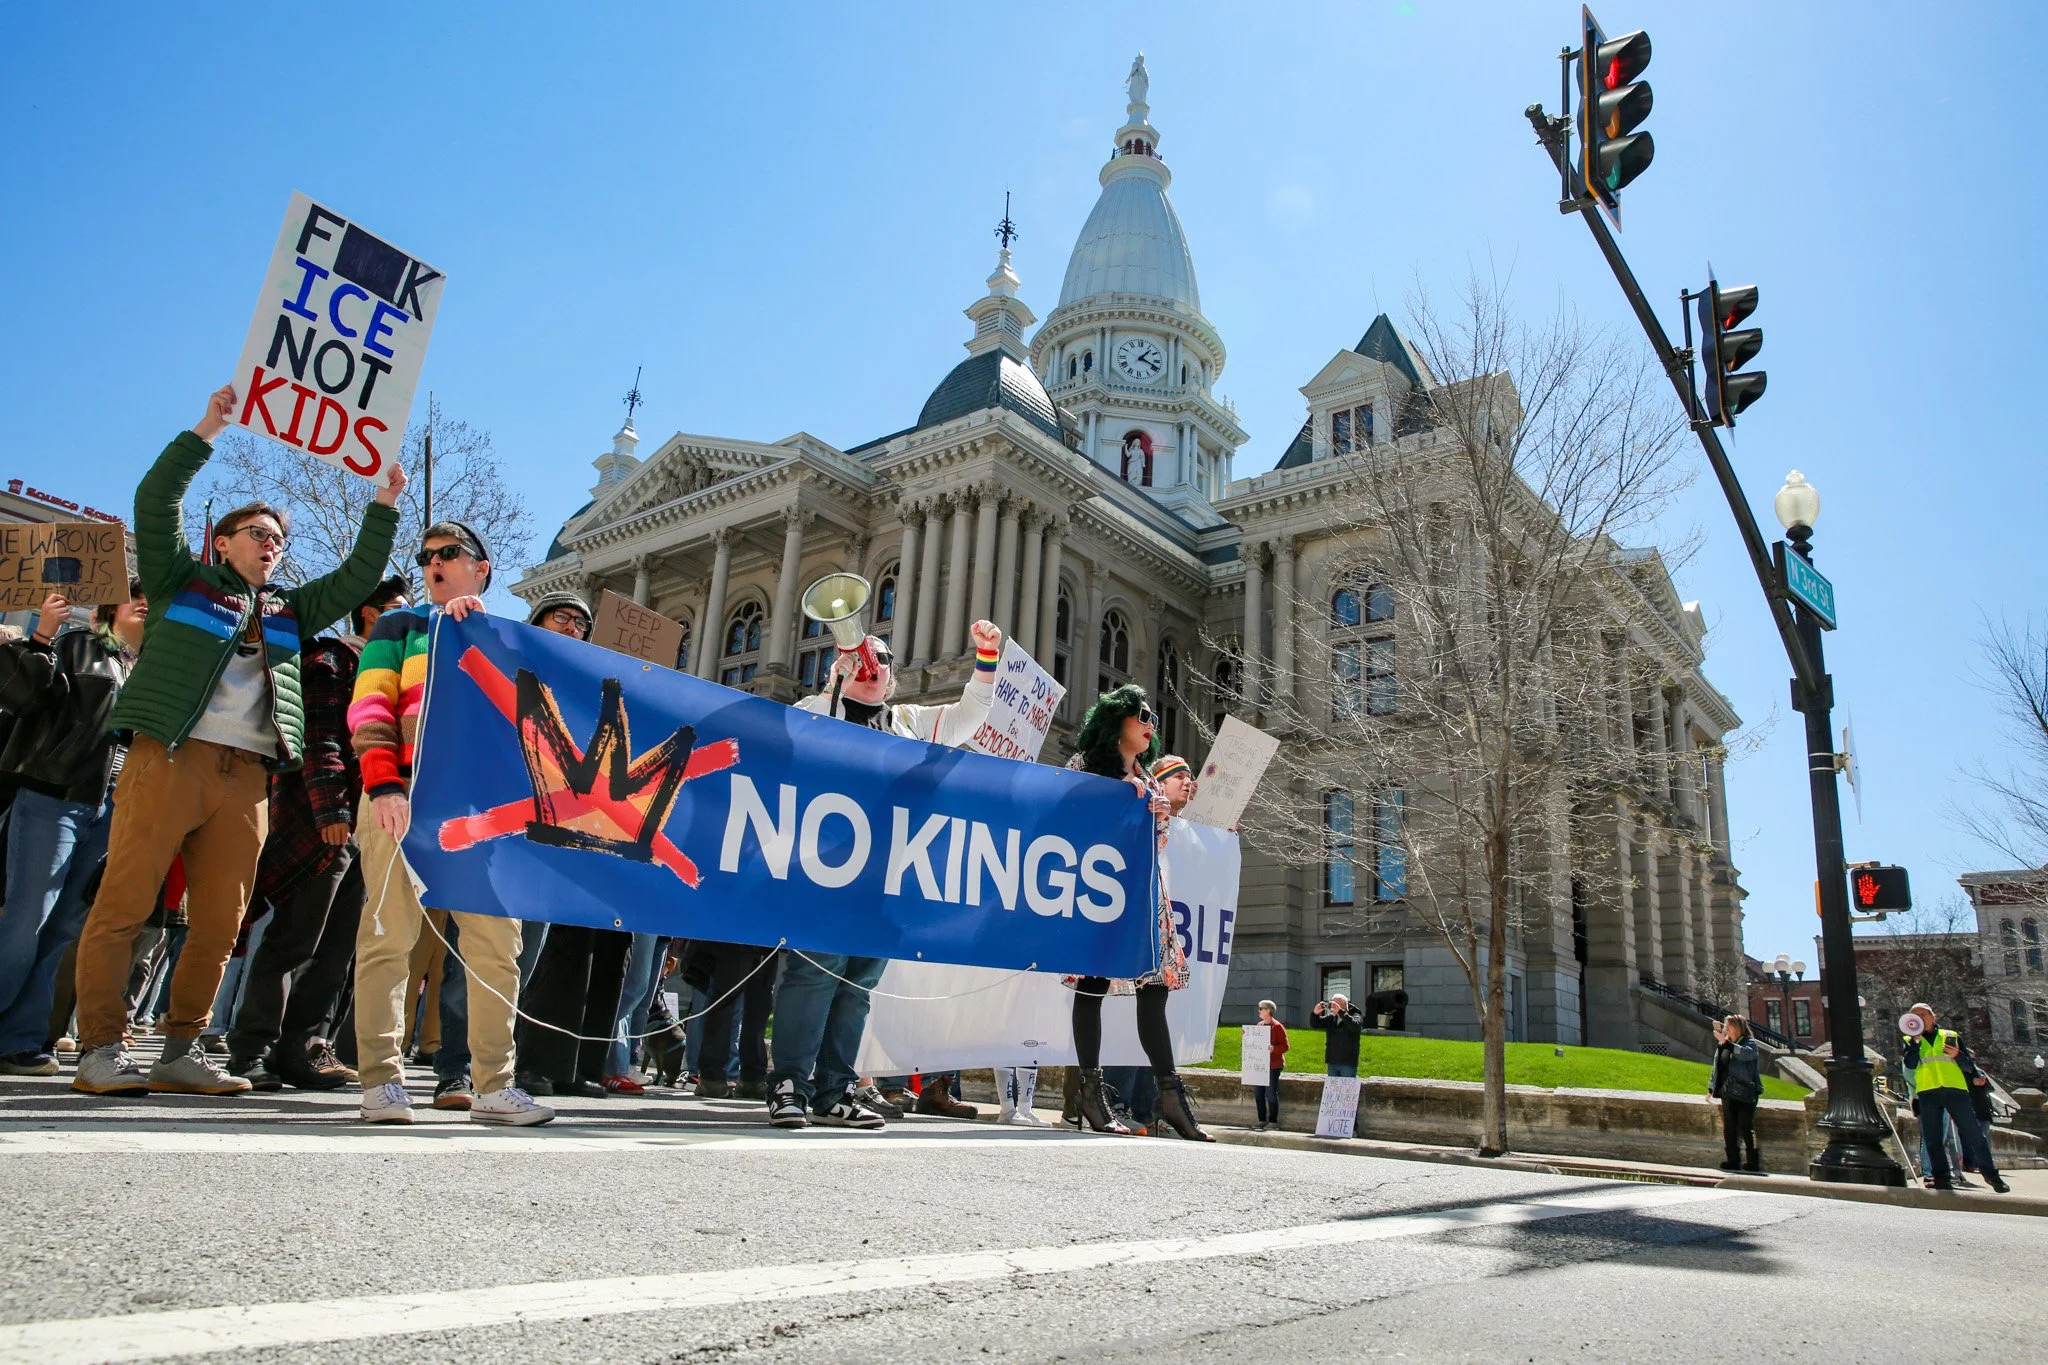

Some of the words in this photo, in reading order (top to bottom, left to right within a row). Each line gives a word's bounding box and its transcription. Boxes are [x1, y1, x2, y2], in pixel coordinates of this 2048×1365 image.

[295, 203, 442, 322] FK
[282, 256, 410, 359] ICE
[265, 313, 393, 411] NOT
[239, 365, 389, 477] KIDS
[30, 529, 116, 555] WRONG
[88, 558, 113, 586] IS
[1790, 558, 1799, 585] N
[1801, 568, 1818, 600] 3rd
[1819, 584, 1830, 610] St
[613, 626, 656, 659] ICE
[615, 601, 661, 635] KEEP
[995, 677, 1019, 707] HAVE
[1017, 695, 1030, 715] TO
[1026, 703, 1051, 736] MARCH
[1007, 660, 1028, 673] WHY
[1031, 676, 1046, 700] DO
[1046, 687, 1058, 712] WE
[719, 772, 872, 889] NO
[883, 805, 1127, 923] KINGS
[1170, 900, 1234, 965] BLE
[1328, 1118, 1351, 1135] VOTE
